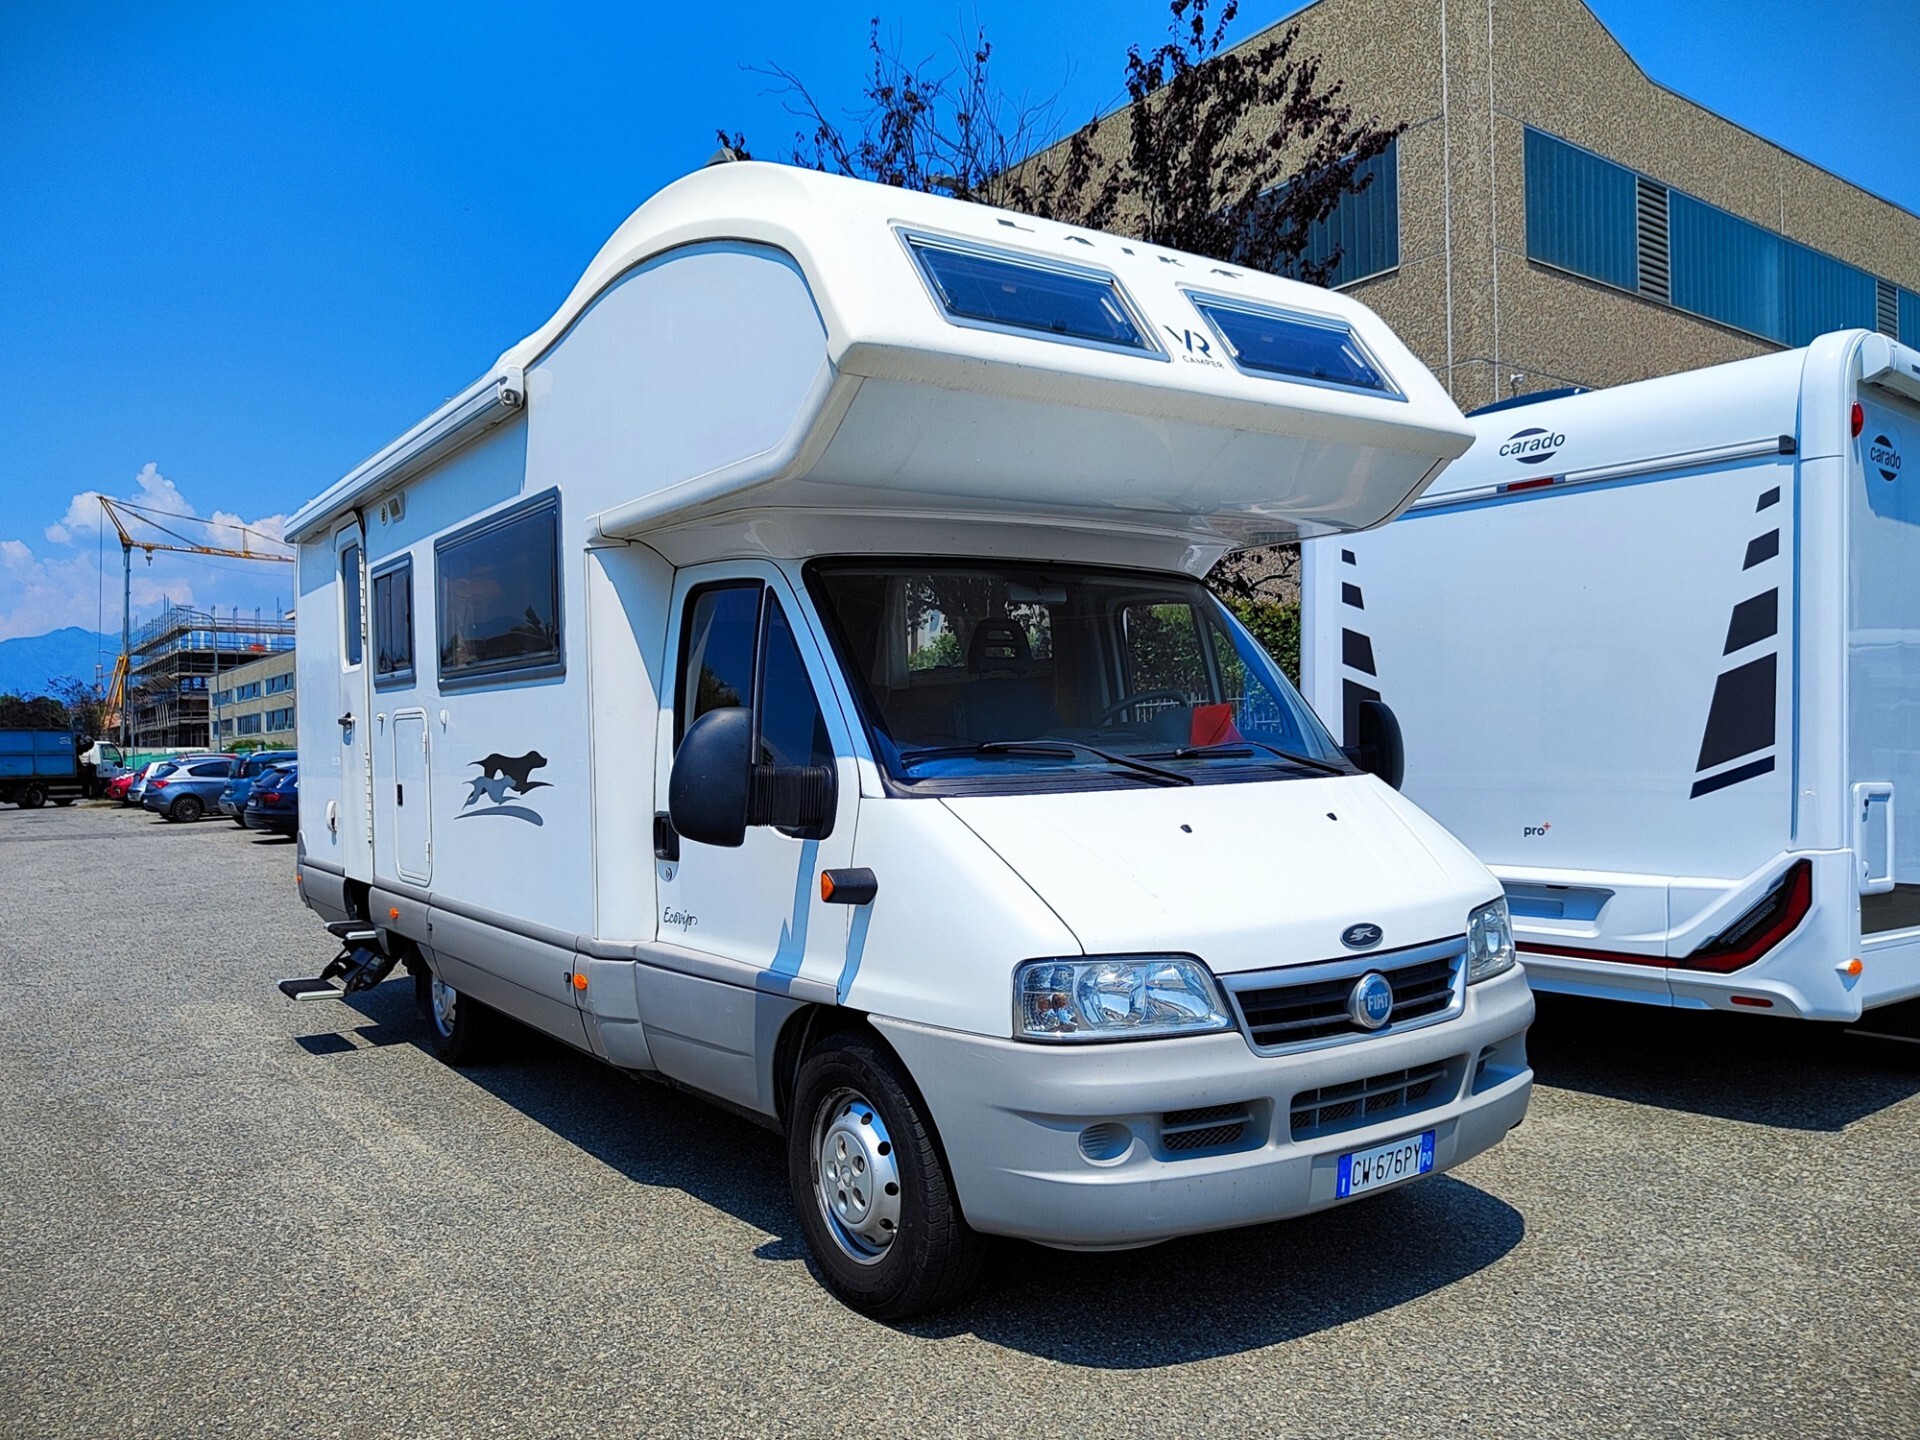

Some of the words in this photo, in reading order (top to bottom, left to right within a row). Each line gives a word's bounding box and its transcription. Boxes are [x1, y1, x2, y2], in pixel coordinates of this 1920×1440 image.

[1182, 355, 1225, 369] CAMPER
[1499, 432, 1565, 456] carado
[1870, 446, 1901, 469] carado
[1367, 993, 1388, 1011] FIAT
